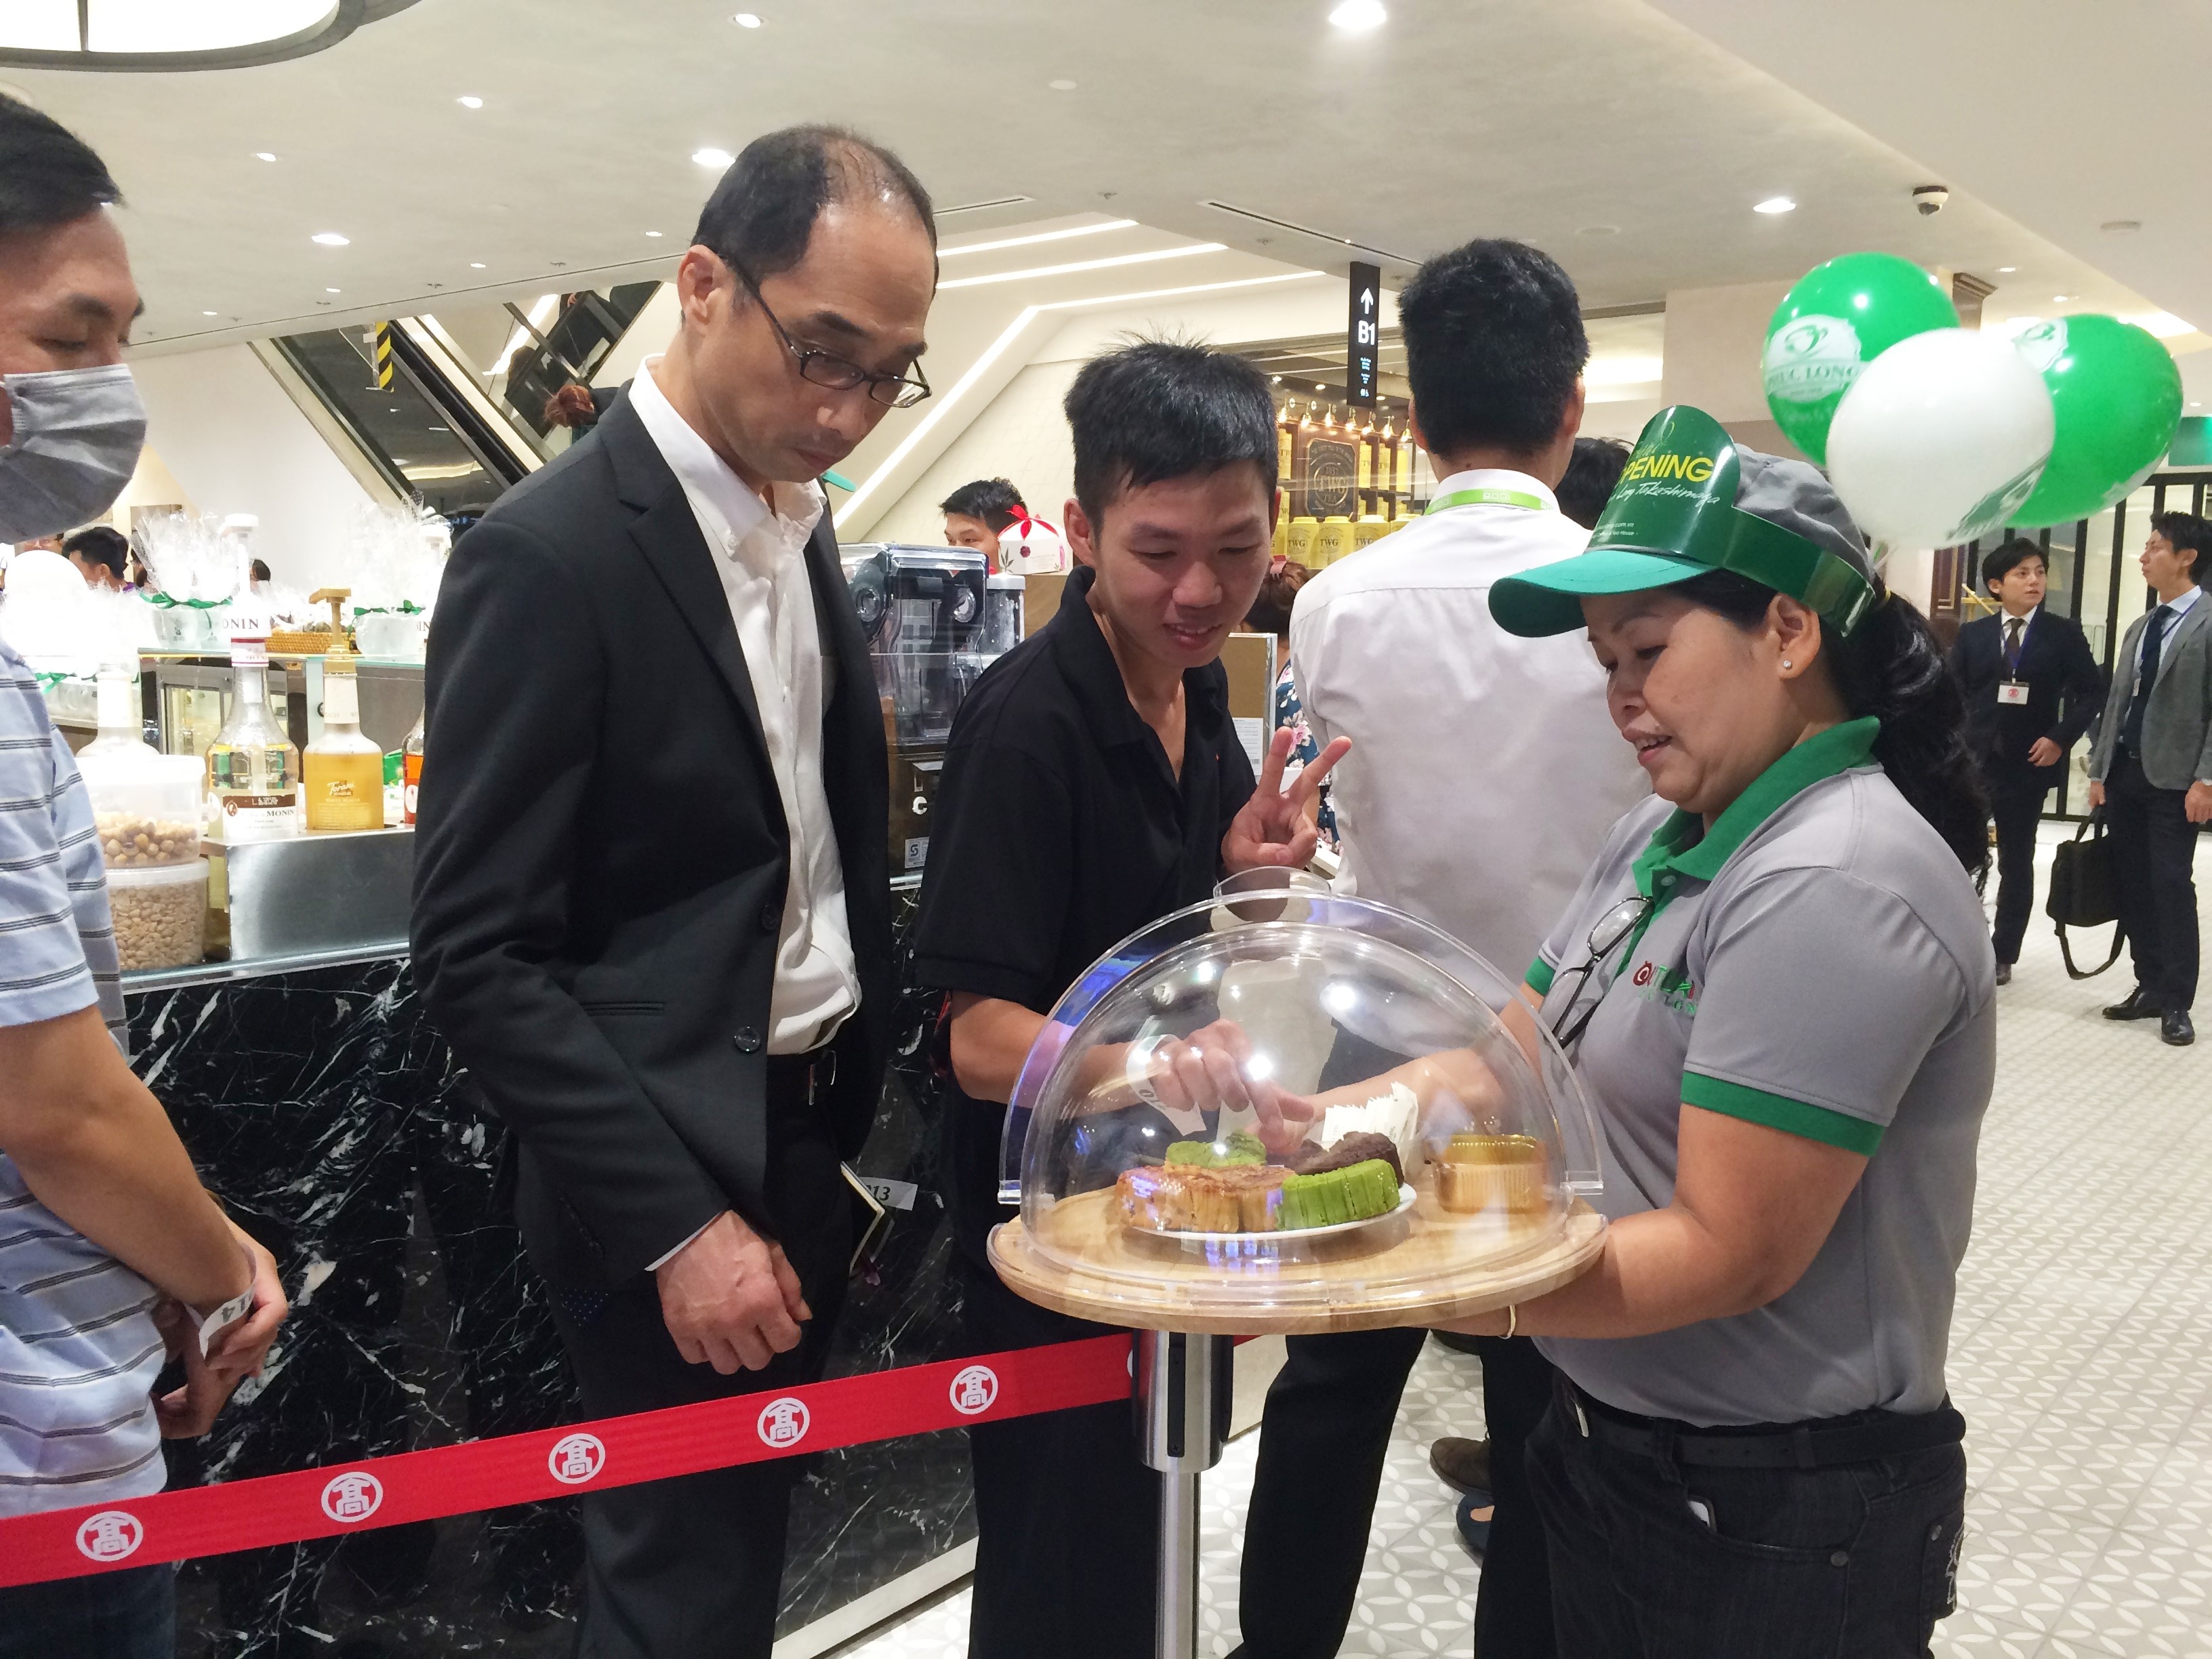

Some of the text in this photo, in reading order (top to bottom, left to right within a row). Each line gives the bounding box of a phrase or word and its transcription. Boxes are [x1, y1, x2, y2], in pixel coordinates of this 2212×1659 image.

[1358, 320, 1375, 345] B1
[1620, 454, 1715, 483] PENING
[1635, 480, 1721, 508] Takashimaya
[1288, 539, 1305, 548] TWG
[1320, 539, 1339, 547] TWG
[266, 809, 295, 817] MONIN
